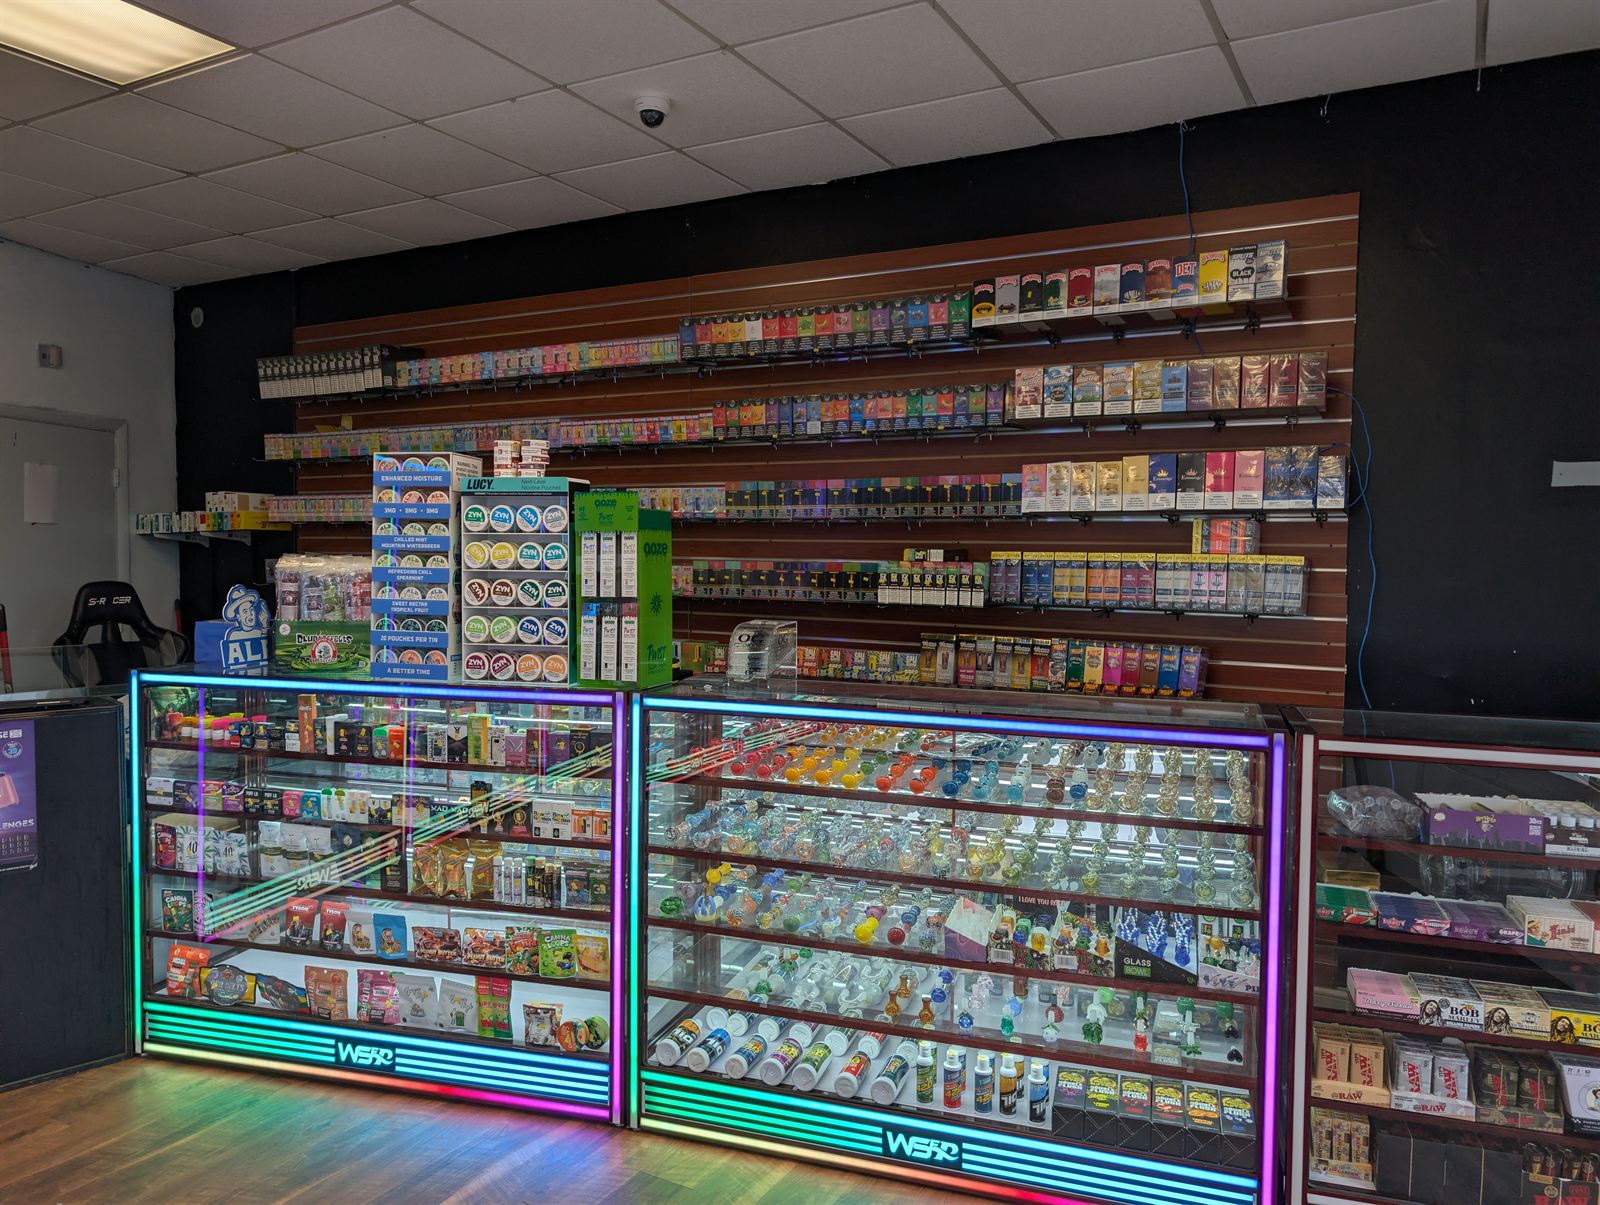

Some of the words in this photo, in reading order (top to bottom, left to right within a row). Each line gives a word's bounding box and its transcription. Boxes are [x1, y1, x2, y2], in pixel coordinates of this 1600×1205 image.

[1233, 269, 1252, 278] BLACK
[466, 479, 494, 490] LUCY
[494, 511, 509, 519] ZYN
[523, 509, 537, 523] ZYN
[546, 511, 561, 520] ZYN
[522, 548, 537, 556] ZYN
[547, 549, 562, 557] ZYN
[643, 542, 668, 556] ooze
[472, 583, 485, 597] ZYN
[495, 585, 510, 593] ZYN
[524, 583, 538, 596] ZYN
[469, 622, 483, 630] ZYN
[493, 621, 508, 631] ZYN
[522, 621, 537, 631] ZYN
[549, 622, 564, 633] ZYN
[468, 658, 482, 666] ZYN
[493, 658, 508, 669] ZYN
[520, 660, 535, 668] ZYN
[548, 660, 563, 669] ZYN
[0, 819, 35, 829] ENGES
[165, 895, 187, 903] CANNA
[1021, 896, 1036, 904] LOVE
[544, 934, 570, 942] CANNA
[547, 940, 569, 948] LOOPS
[1123, 957, 1152, 967] GLASS
[1124, 967, 1149, 976] BOWL
[1450, 1006, 1480, 1018] BOB
[1448, 1015, 1480, 1023] MARLEY
[1324, 1048, 1338, 1081] RAW
[1359, 1053, 1374, 1087] RAW
[1407, 1061, 1421, 1093] RAW
[1442, 1066, 1458, 1100] RAW
[1338, 1092, 1363, 1100] RAW
[1420, 1104, 1446, 1112] RAW
